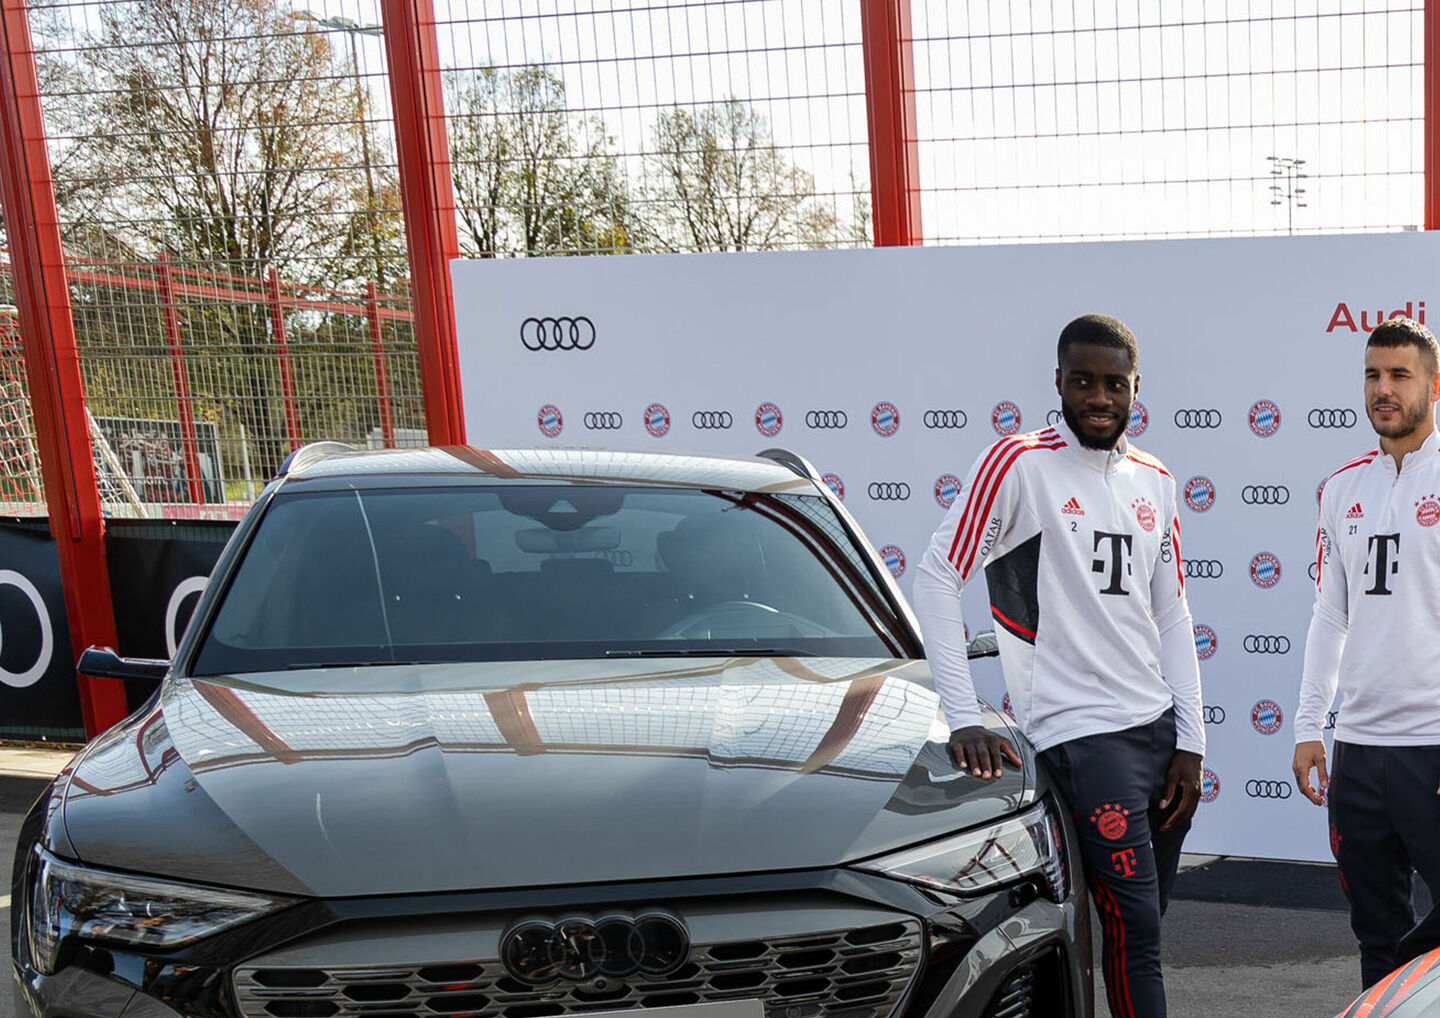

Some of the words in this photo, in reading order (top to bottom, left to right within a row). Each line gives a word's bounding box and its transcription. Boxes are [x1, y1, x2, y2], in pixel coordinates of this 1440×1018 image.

[1326, 302, 1425, 332] Audi
[981, 517, 1000, 556] QATAR
[1071, 521, 1078, 532] 2
[1348, 525, 1358, 535] 21
